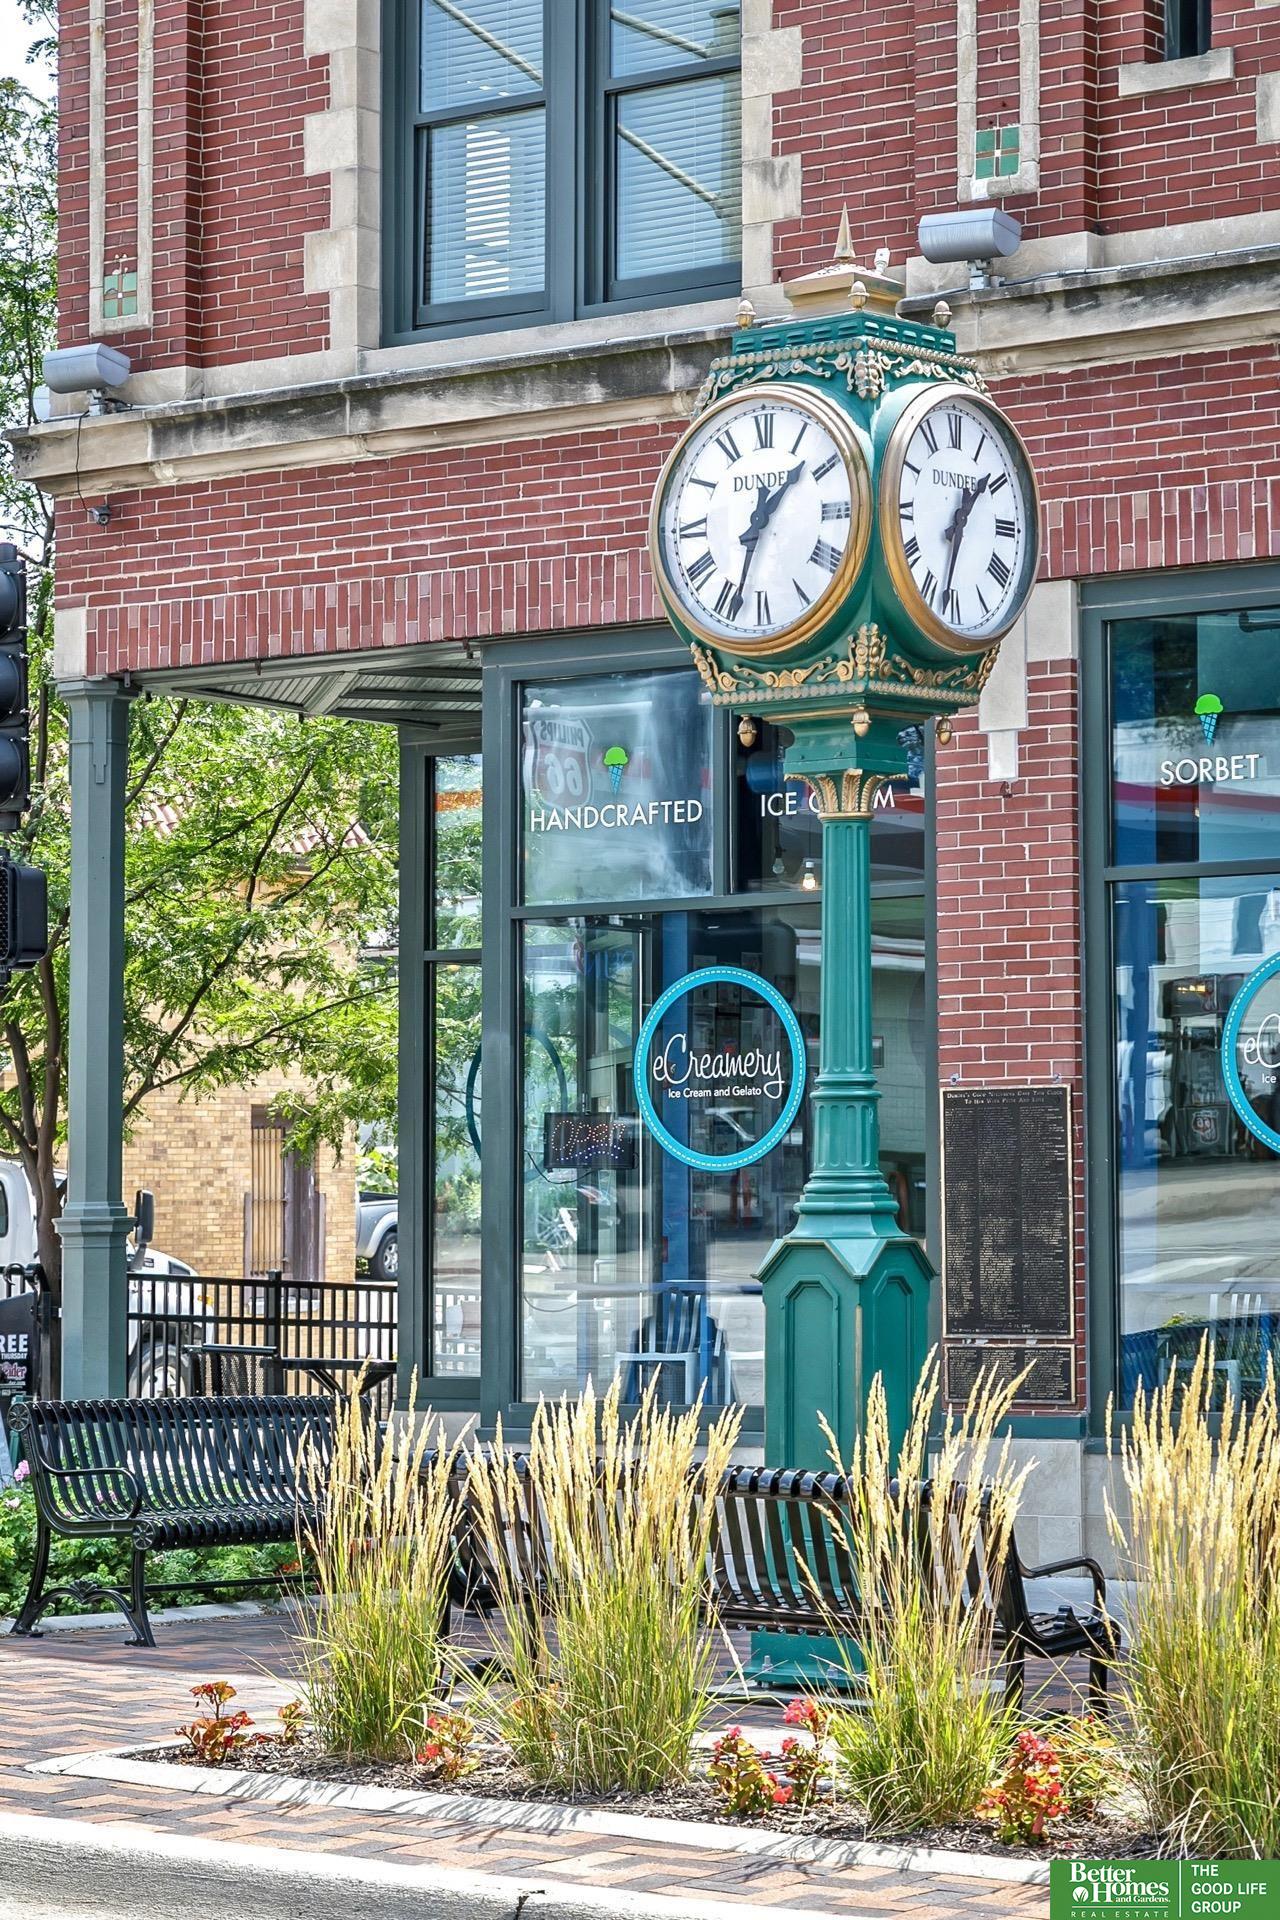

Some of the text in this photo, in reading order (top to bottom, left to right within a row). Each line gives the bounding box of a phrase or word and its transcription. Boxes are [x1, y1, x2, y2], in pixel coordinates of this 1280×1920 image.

[712, 426, 743, 470] XI
[752, 412, 776, 452] XII
[945, 412, 963, 452] XII
[733, 471, 787, 492] DUNDE
[811, 449, 841, 485] II
[933, 469, 977, 492] DUNDEE
[987, 467, 1009, 499] II
[994, 514, 1015, 542] III
[1160, 753, 1260, 786] SORBET
[530, 799, 703, 832] HANDCRAFTED
[761, 791, 797, 817] ICE
[653, 1033, 785, 1099] eCreamery
[1262, 1073, 1277, 1084] Ice
[668, 1085, 762, 1098] Ice Cream and Gelato
[0, 1334, 28, 1353] REE
